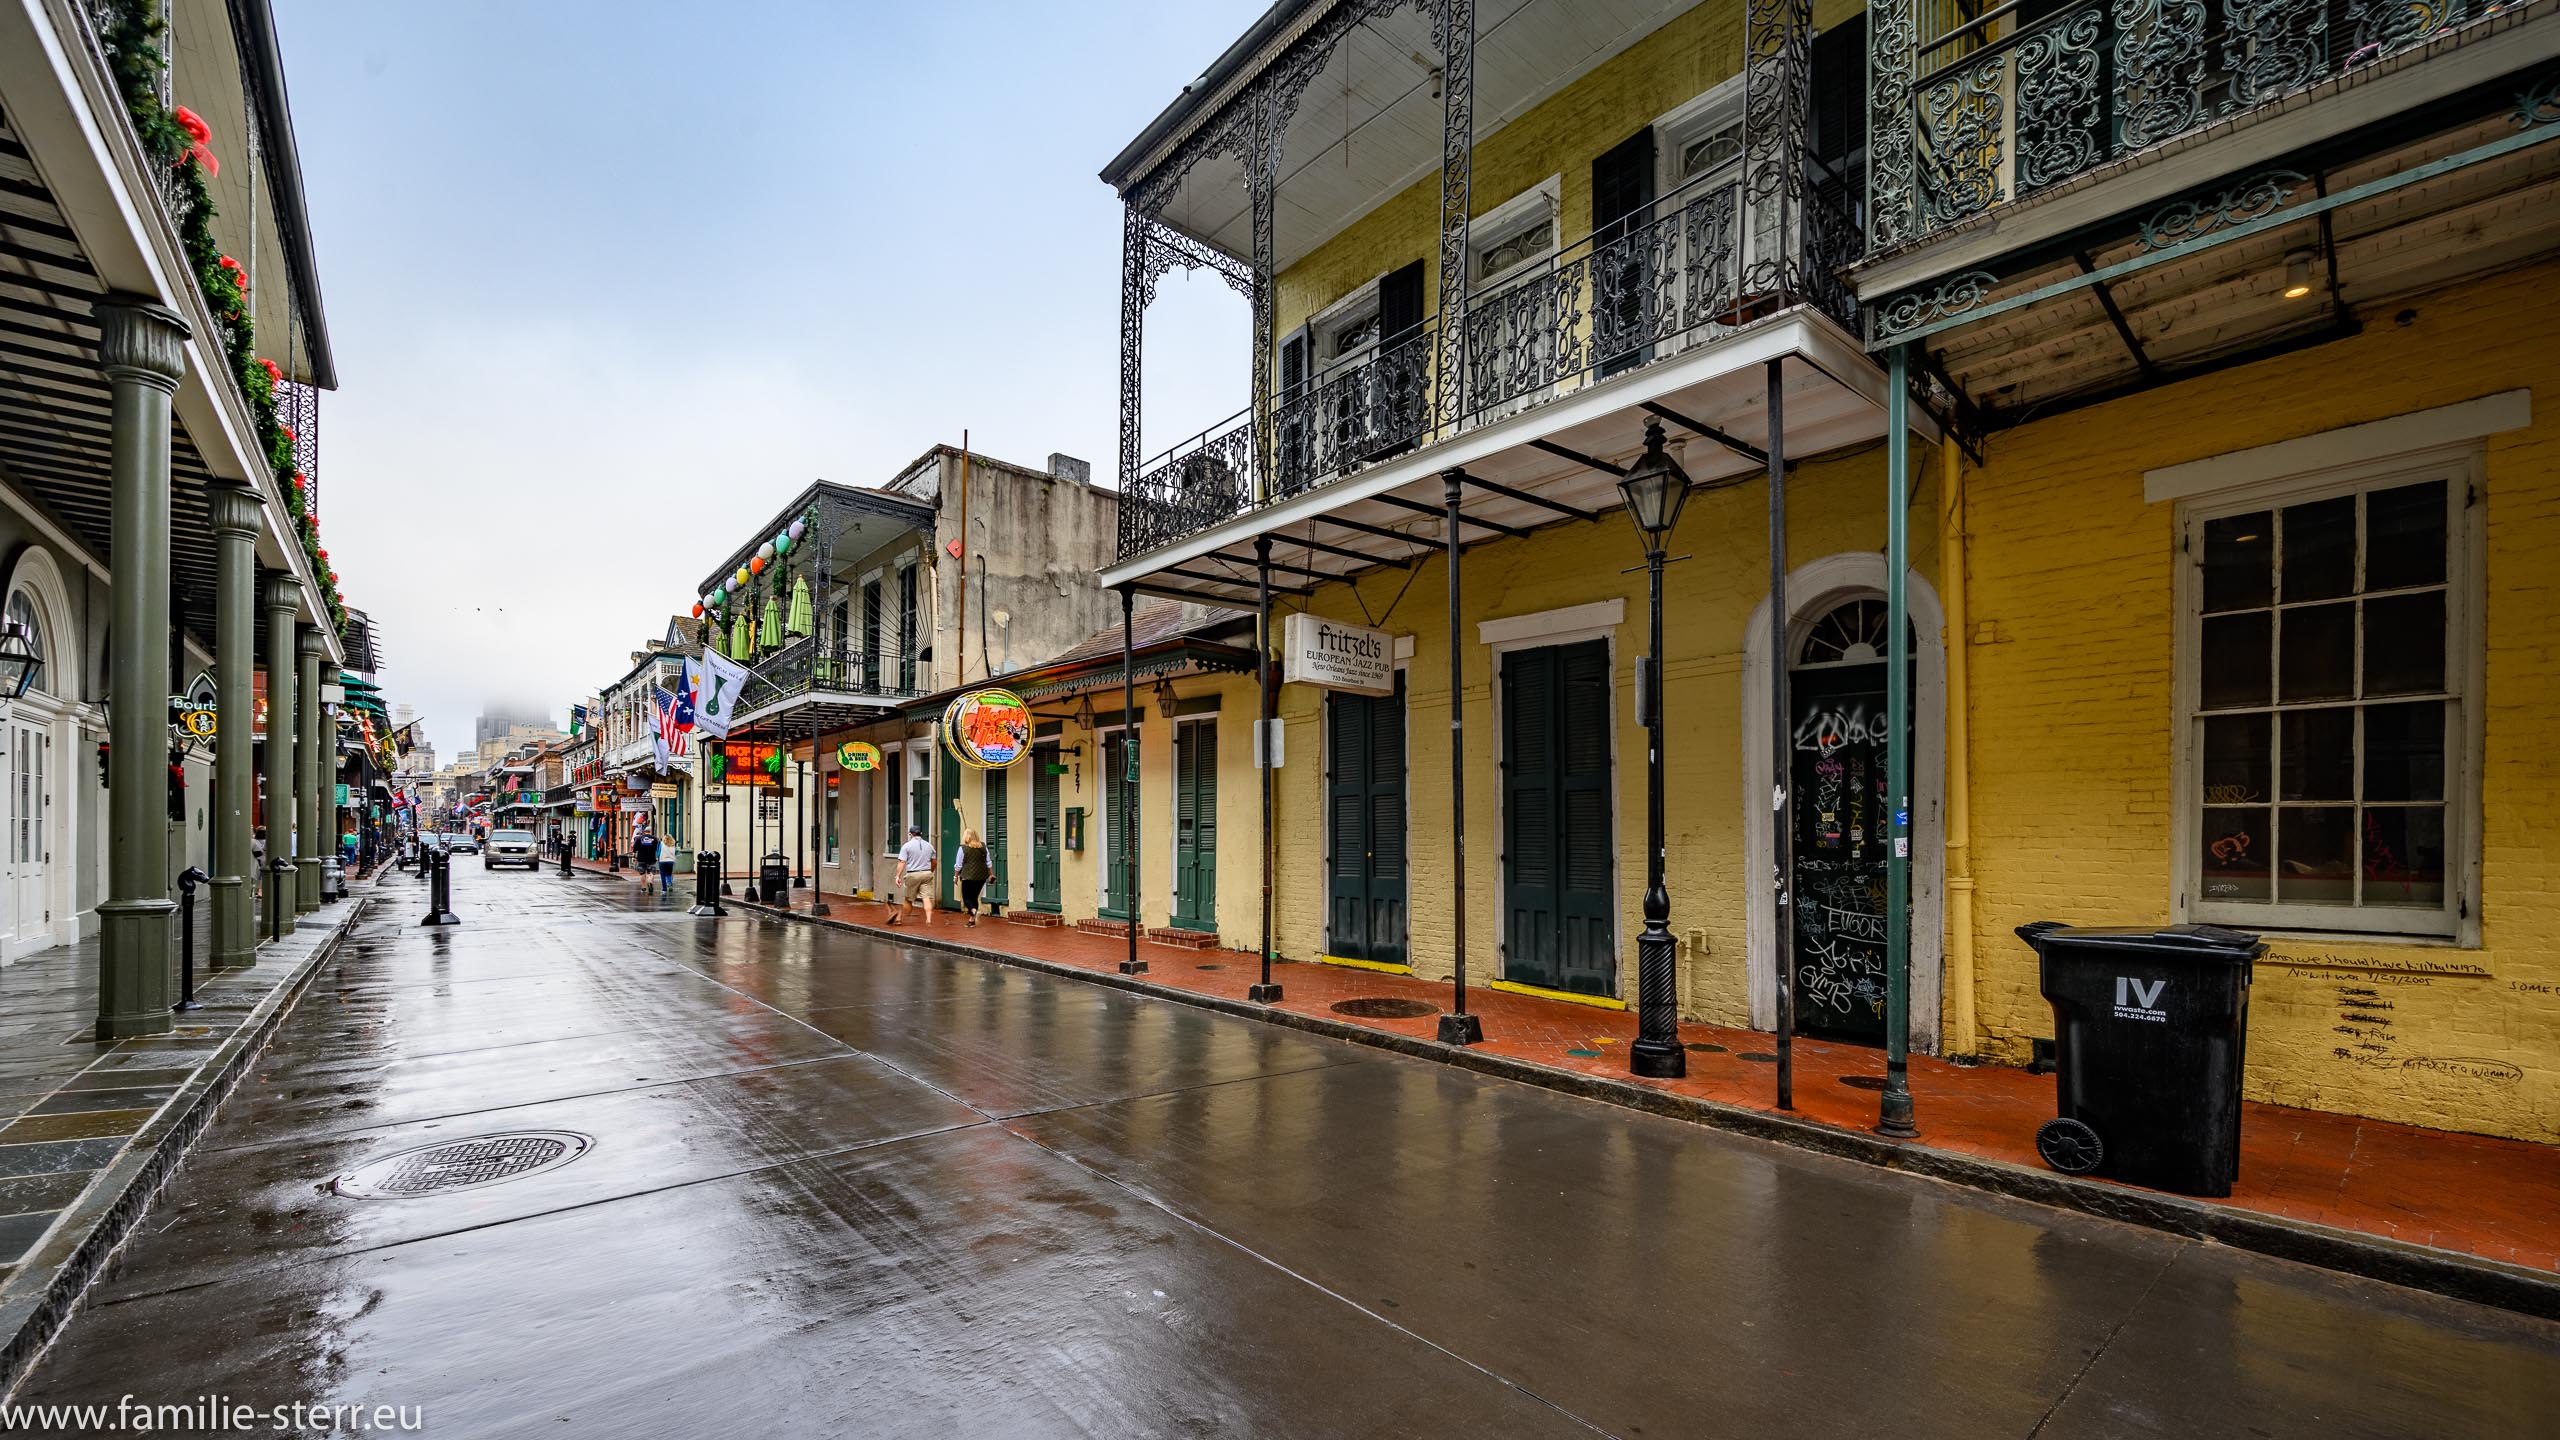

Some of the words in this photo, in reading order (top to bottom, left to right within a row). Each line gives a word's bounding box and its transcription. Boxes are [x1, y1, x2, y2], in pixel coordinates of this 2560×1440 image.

[1306, 650, 1352, 666] EUROPEAN
[1353, 659, 1373, 670] JAZZ
[1374, 662, 1390, 673] PUB
[1312, 661, 1326, 671] New
[1326, 664, 1346, 674] Orleans
[1345, 668, 1358, 676] Jazz
[1358, 670, 1373, 678] since
[200, 715, 208, 733] BAR
[726, 746, 774, 759] TROPCAL
[2296, 956, 2321, 965] we
[2460, 964, 2486, 974] 1970
[2321, 971, 2330, 980] it
[2335, 973, 2360, 981] was
[2116, 976, 2166, 1009] IV
[2509, 981, 2551, 994] SOME
[2114, 1011, 2166, 1023] 504.224.6670
